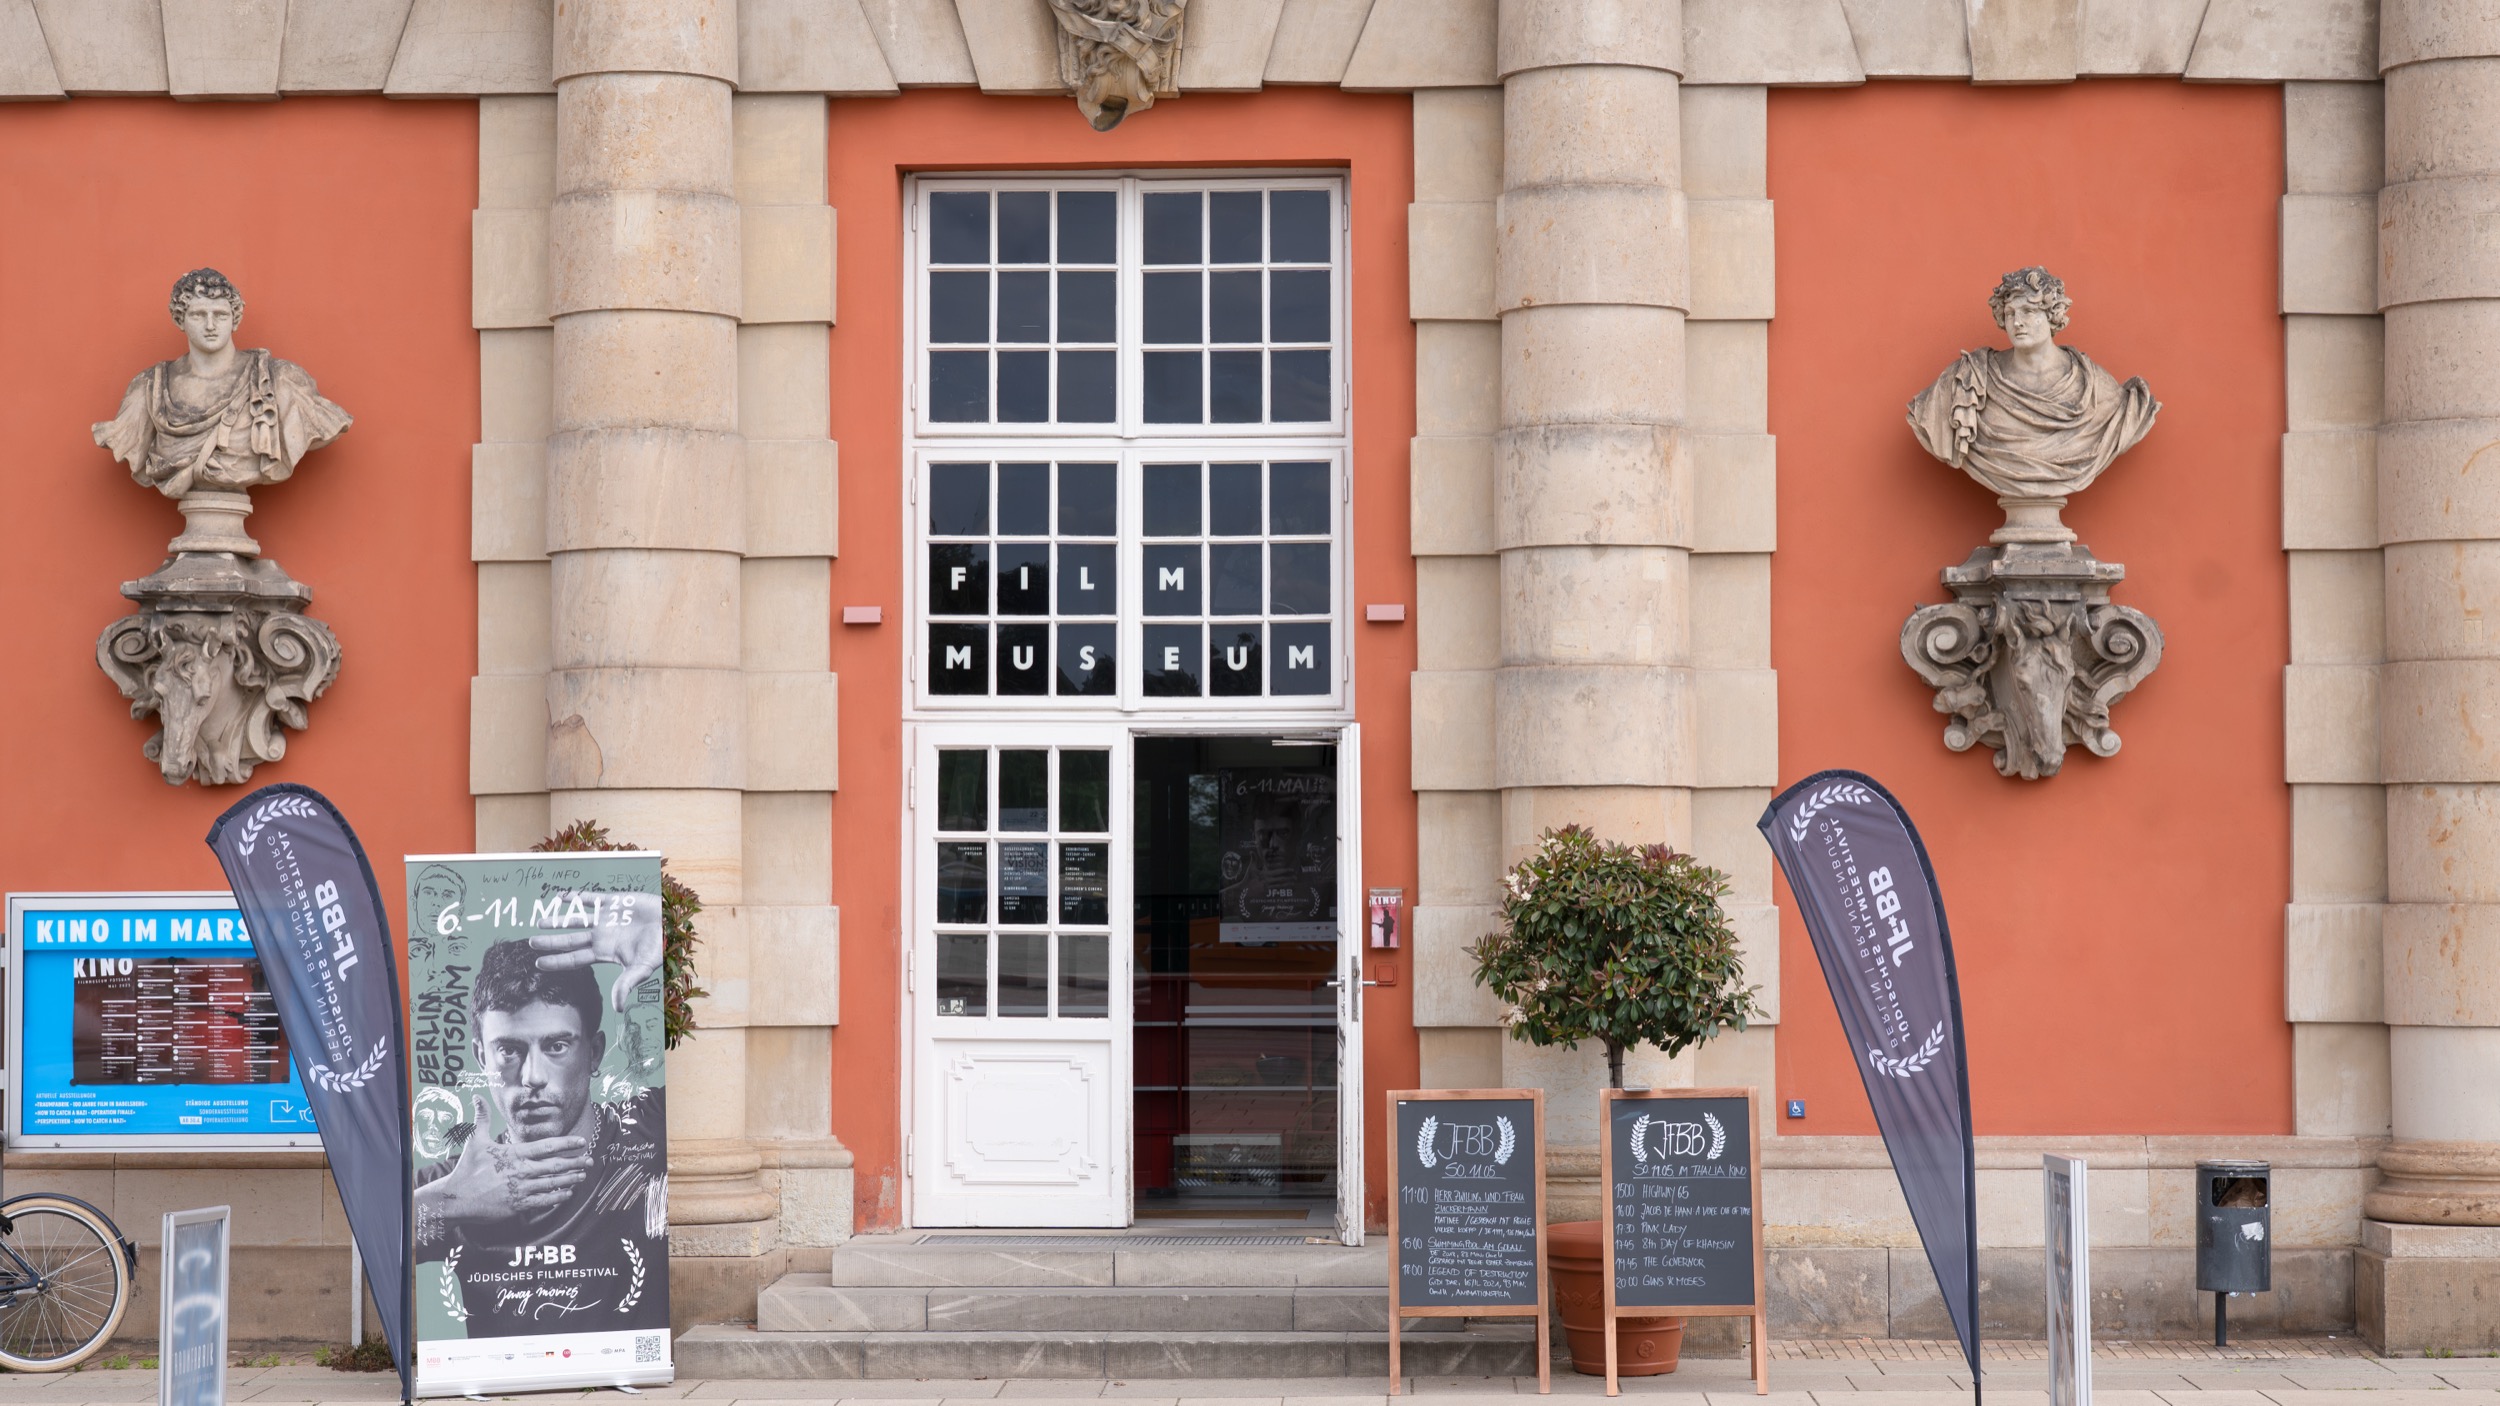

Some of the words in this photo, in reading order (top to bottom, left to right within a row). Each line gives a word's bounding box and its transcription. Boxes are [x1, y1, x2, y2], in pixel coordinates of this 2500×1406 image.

[951, 566, 1184, 591] FILM
[945, 645, 1314, 671] MUSEUM
[1277, 778, 1309, 793] MAI
[552, 870, 580, 880] INFO
[609, 894, 636, 911] 20
[1372, 896, 1397, 905] KINO
[529, 895, 601, 928] MAI
[605, 909, 635, 927] 25
[36, 918, 110, 944] KINO
[122, 918, 157, 942] IM
[74, 958, 134, 978] KINO
[441, 964, 472, 1087] POTSDAM
[416, 992, 441, 1085] BERLIN
[1437, 1122, 1494, 1159] JFBB
[1648, 1121, 1705, 1160] JFBB
[1691, 1164, 1726, 1176] THALIA
[1728, 1164, 1747, 1177] KINO
[1401, 1185, 1429, 1204] 11:00
[1484, 1191, 1501, 1202] UND
[1502, 1190, 1525, 1202] FRAU
[1642, 1183, 1676, 1204] HIGHWAY
[1677, 1185, 1690, 1199] 65
[1663, 1205, 1672, 1217] DE
[1640, 1221, 1660, 1235] PINK
[1662, 1223, 1688, 1240] LADY
[1642, 1237, 1657, 1249] 8th
[1660, 1238, 1679, 1255] DAY
[1682, 1239, 1695, 1248] OF
[1696, 1238, 1735, 1250] KHAMSIN
[1643, 1256, 1659, 1268] THE
[1661, 1255, 1706, 1269] GOVERNOR
[467, 1270, 533, 1283] JÜDISCHES
[537, 1267, 619, 1280] FILMFESTIVAL
[1428, 1266, 1460, 1275] LEGEND
[1464, 1268, 1477, 1278] OF
[1479, 1269, 1528, 1278] DESTRUCTION
[1642, 1274, 1664, 1287] GUNS
[1676, 1276, 1706, 1287] MOSES
